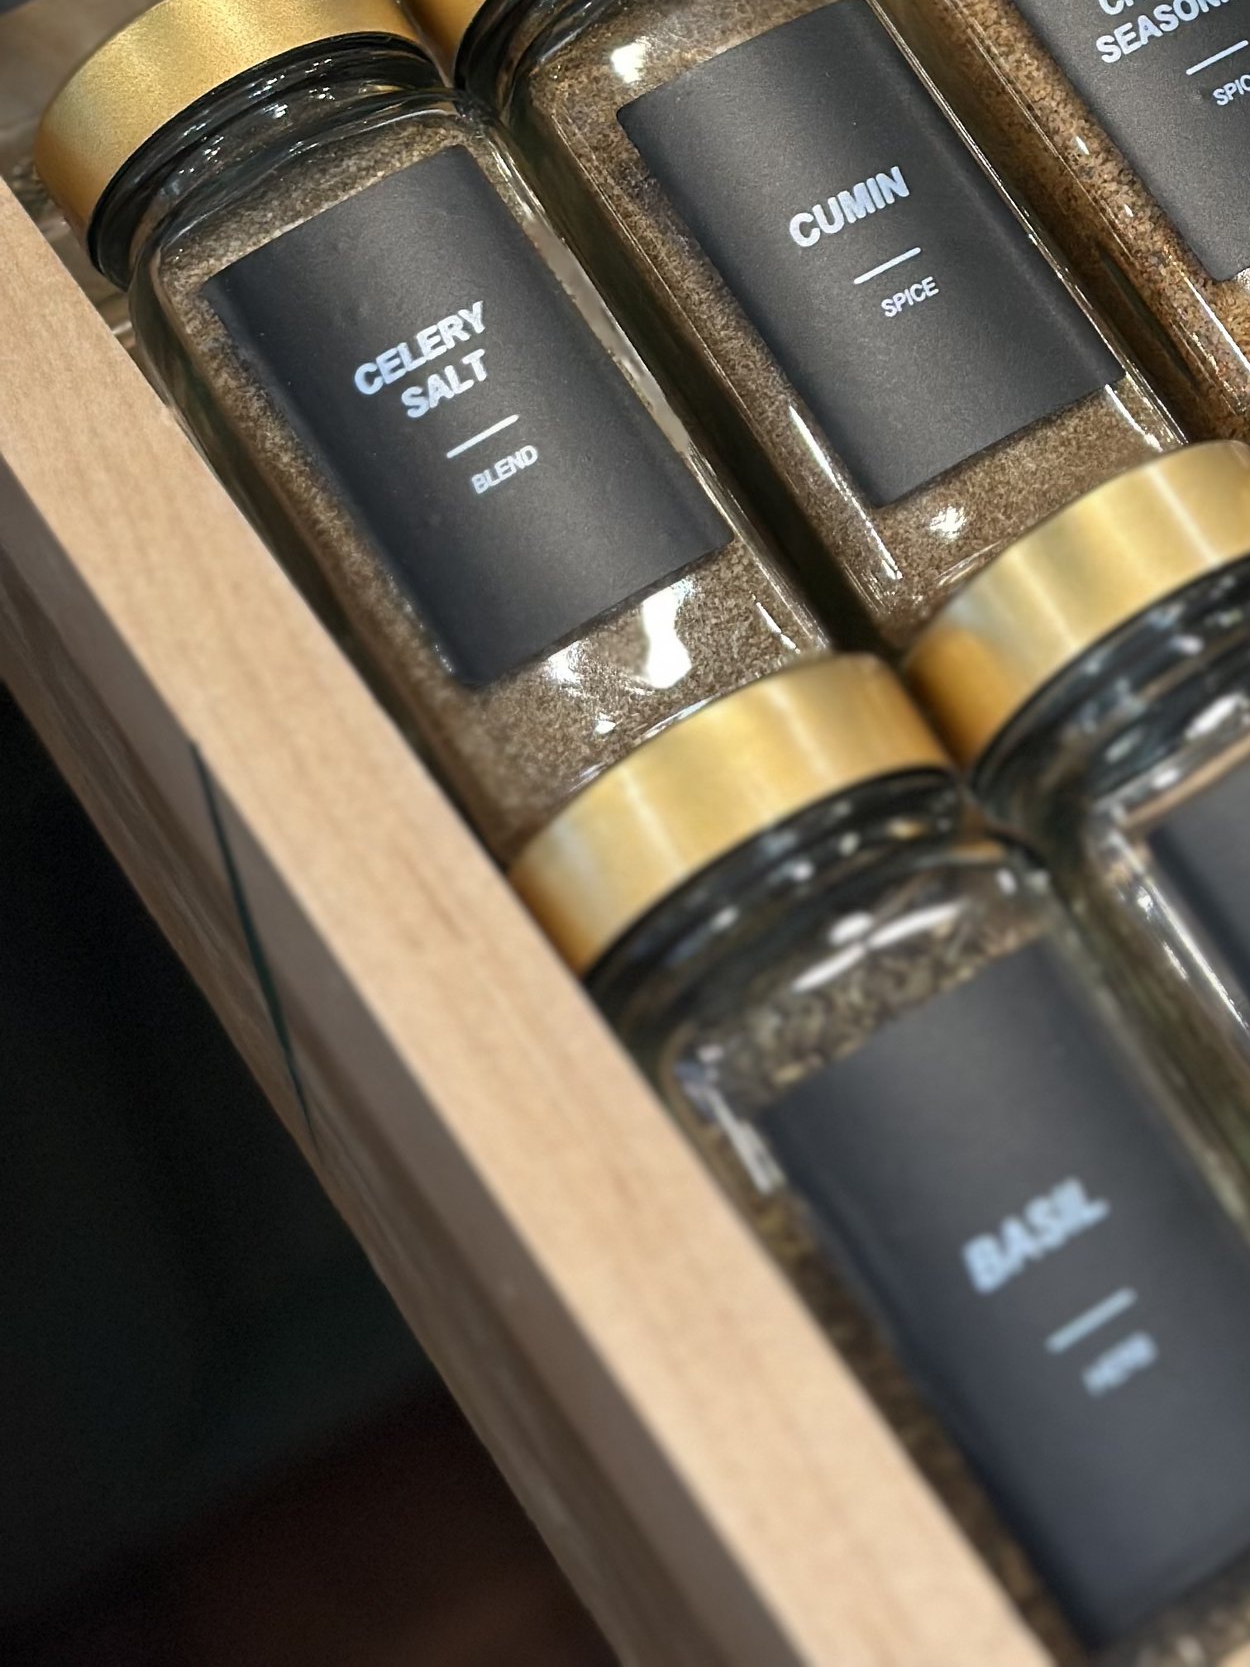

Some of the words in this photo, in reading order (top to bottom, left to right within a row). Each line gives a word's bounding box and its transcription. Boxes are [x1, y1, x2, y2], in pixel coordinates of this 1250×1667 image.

[789, 166, 910, 247] CUMIN
[881, 276, 939, 317] SPICE
[354, 300, 485, 395] CELERY
[401, 348, 487, 418] SALT
[471, 445, 538, 494] BLEND
[962, 1177, 1110, 1295] BASIL
